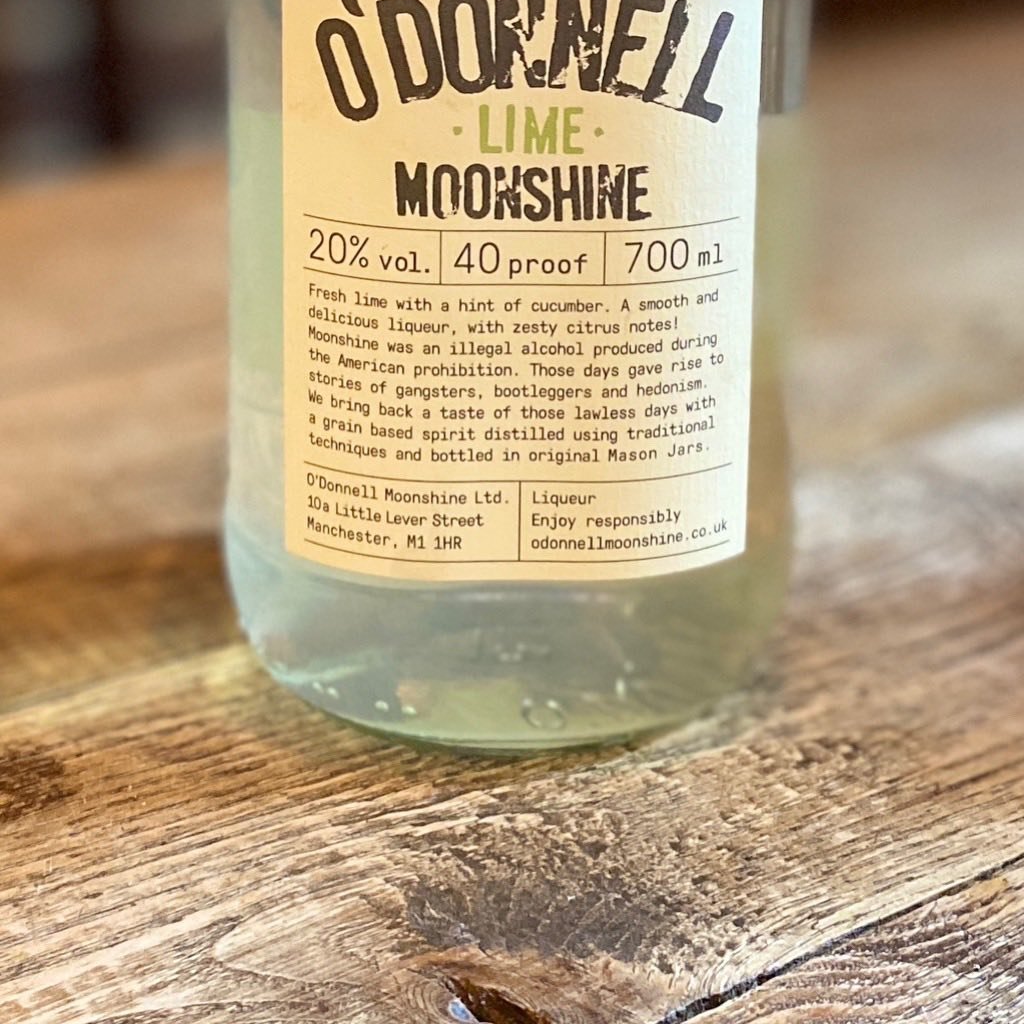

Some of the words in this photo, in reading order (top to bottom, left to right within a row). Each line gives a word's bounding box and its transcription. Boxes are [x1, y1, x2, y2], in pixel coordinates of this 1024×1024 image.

[479, 104, 584, 155] LIME
[395, 161, 652, 222] MOONSHINE
[309, 228, 369, 268] 20%
[379, 251, 431, 274] vol.
[454, 241, 500, 274] 40
[509, 253, 588, 281] proof
[624, 237, 689, 273] 700
[697, 243, 724, 267] ml
[309, 283, 346, 303] Fresh
[355, 291, 388, 309] lime
[396, 298, 432, 311] with
[441, 302, 449, 312] a
[459, 298, 495, 312] hint
[504, 298, 521, 312] of
[531, 299, 609, 313] cucumber.
[621, 298, 630, 312] A
[639, 294, 689, 311] smooth
[696, 288, 719, 305] and
[308, 305, 379, 330] delicious
[388, 317, 456, 336] liqueur,
[468, 320, 504, 334] with
[513, 321, 558, 337] zesty
[567, 321, 620, 334] citrus
[629, 316, 677, 333] notes!
[308, 325, 379, 351] Moonshine
[387, 342, 413, 354] was
[422, 344, 440, 355] an
[450, 341, 512, 358] illegal
[521, 341, 584, 356] alcohol
[593, 339, 663, 359] produced
[671, 334, 717, 351] during
[309, 347, 331, 364] the
[338, 353, 405, 375] American
[414, 363, 518, 379] prohibition.
[529, 362, 575, 377] Those
[583, 363, 619, 380] days
[628, 364, 663, 380] gave
[671, 358, 702, 372] rise
[710, 353, 724, 365] to
[309, 370, 362, 391] stories
[370, 381, 387, 394] of
[396, 385, 482, 401] gangsters,
[494, 384, 592, 401] bootleggers
[601, 384, 628, 398] and
[636, 379, 707, 397] hedonism.
[308, 389, 323, 405] We
[331, 394, 370, 417] bring
[379, 402, 413, 418] back
[422, 408, 431, 419] a
[440, 406, 485, 420] taste
[493, 405, 511, 419] of
[520, 405, 565, 420] those
[575, 405, 636, 420] lawless
[645, 404, 678, 419] days
[686, 395, 716, 412] with
[309, 413, 316, 424] a
[323, 417, 362, 434] grain
[370, 423, 413, 440] based
[422, 427, 476, 444] spirit
[484, 426, 564, 441] distilled
[573, 427, 618, 445] using
[627, 415, 715, 441] traditional
[308, 431, 387, 459] techniques
[396, 448, 422, 461] and
[431, 448, 493, 462] bottled
[503, 451, 520, 462] in
[529, 448, 599, 466] original
[608, 449, 657, 462] Mason
[667, 442, 709, 457] Jars.
[306, 472, 378, 501] O'Donnell
[385, 488, 467, 505] Moonshine
[475, 490, 508, 504] Ltd.
[533, 490, 596, 508] Liqueur
[308, 495, 329, 513] 10a
[335, 502, 382, 523] Little
[386, 511, 427, 526] Lever
[432, 513, 484, 527] Street
[532, 513, 576, 530] Enjoy
[586, 508, 681, 530] responsibly
[307, 517, 398, 549] Manchester,
[407, 534, 425, 549] M1
[434, 536, 462, 550] 1HR
[531, 518, 728, 551] odonnellmoonshine.co.uk
